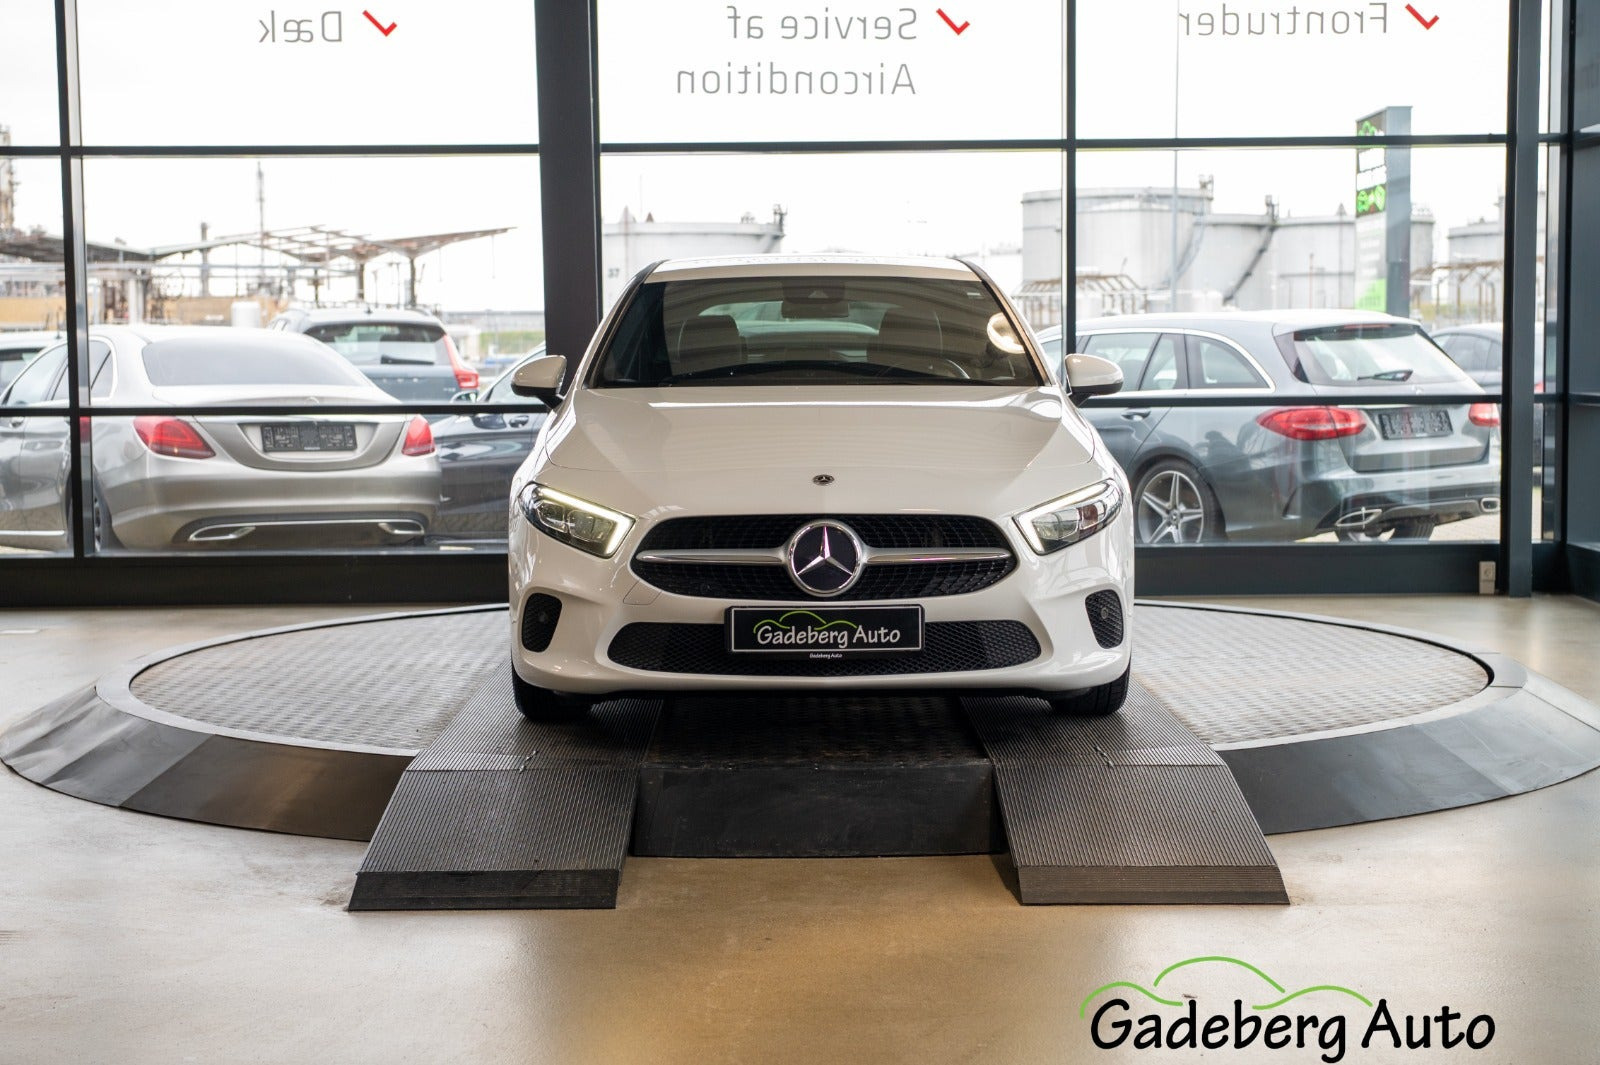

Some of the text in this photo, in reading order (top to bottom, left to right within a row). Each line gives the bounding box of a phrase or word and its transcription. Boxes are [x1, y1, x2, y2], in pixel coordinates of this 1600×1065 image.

[757, 625, 901, 649] Gadeberg Auto
[809, 652, 831, 660] Gadeberg
